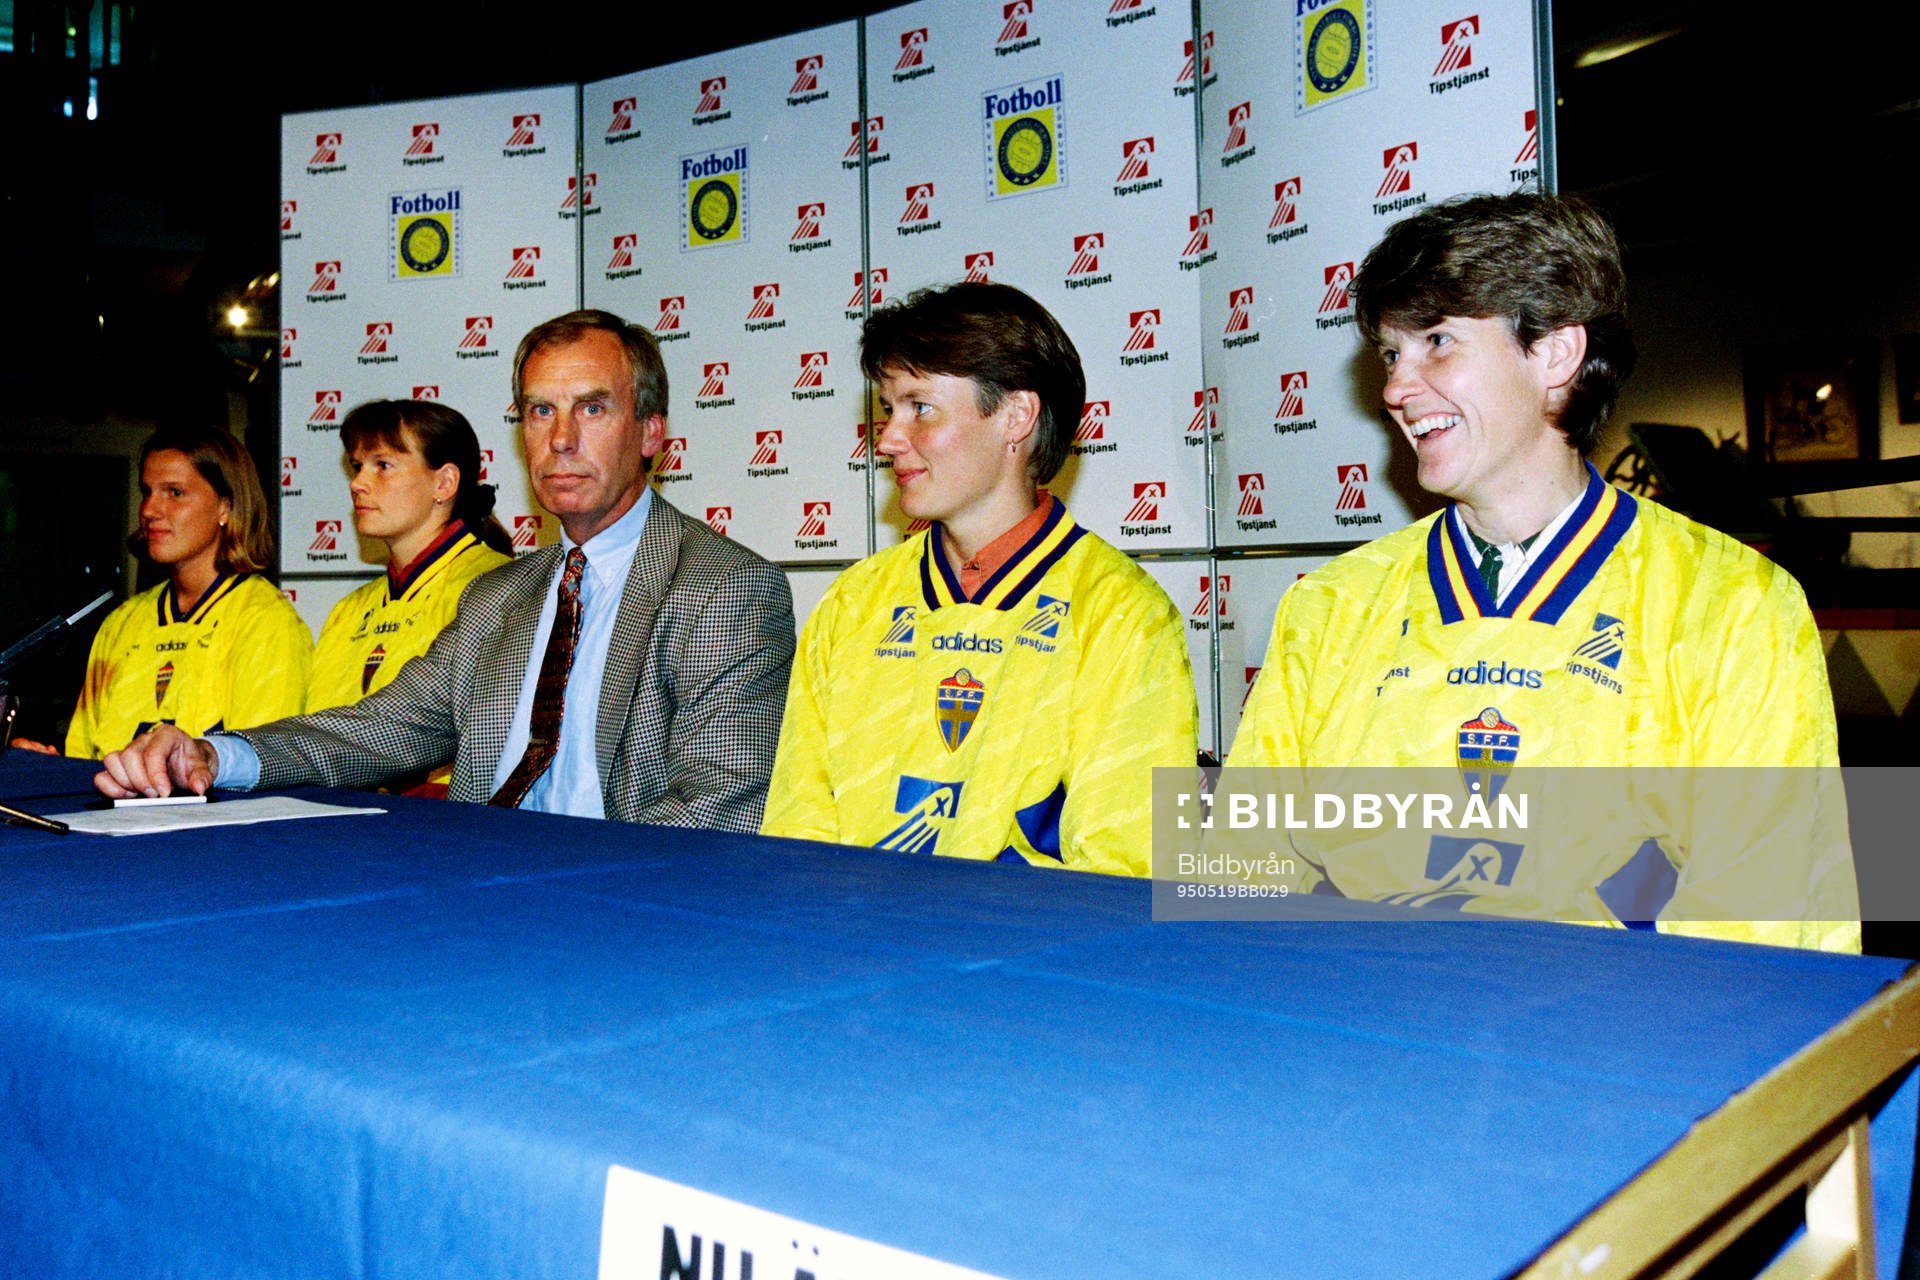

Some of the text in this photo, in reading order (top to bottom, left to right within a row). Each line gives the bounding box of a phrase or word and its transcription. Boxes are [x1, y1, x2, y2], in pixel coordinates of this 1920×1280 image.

[984, 78, 1062, 119] Fotboll
[682, 147, 747, 180] Fotboll
[391, 190, 460, 215] Fotboll
[931, 632, 1004, 654] adidas
[1446, 659, 1543, 689] adidas
